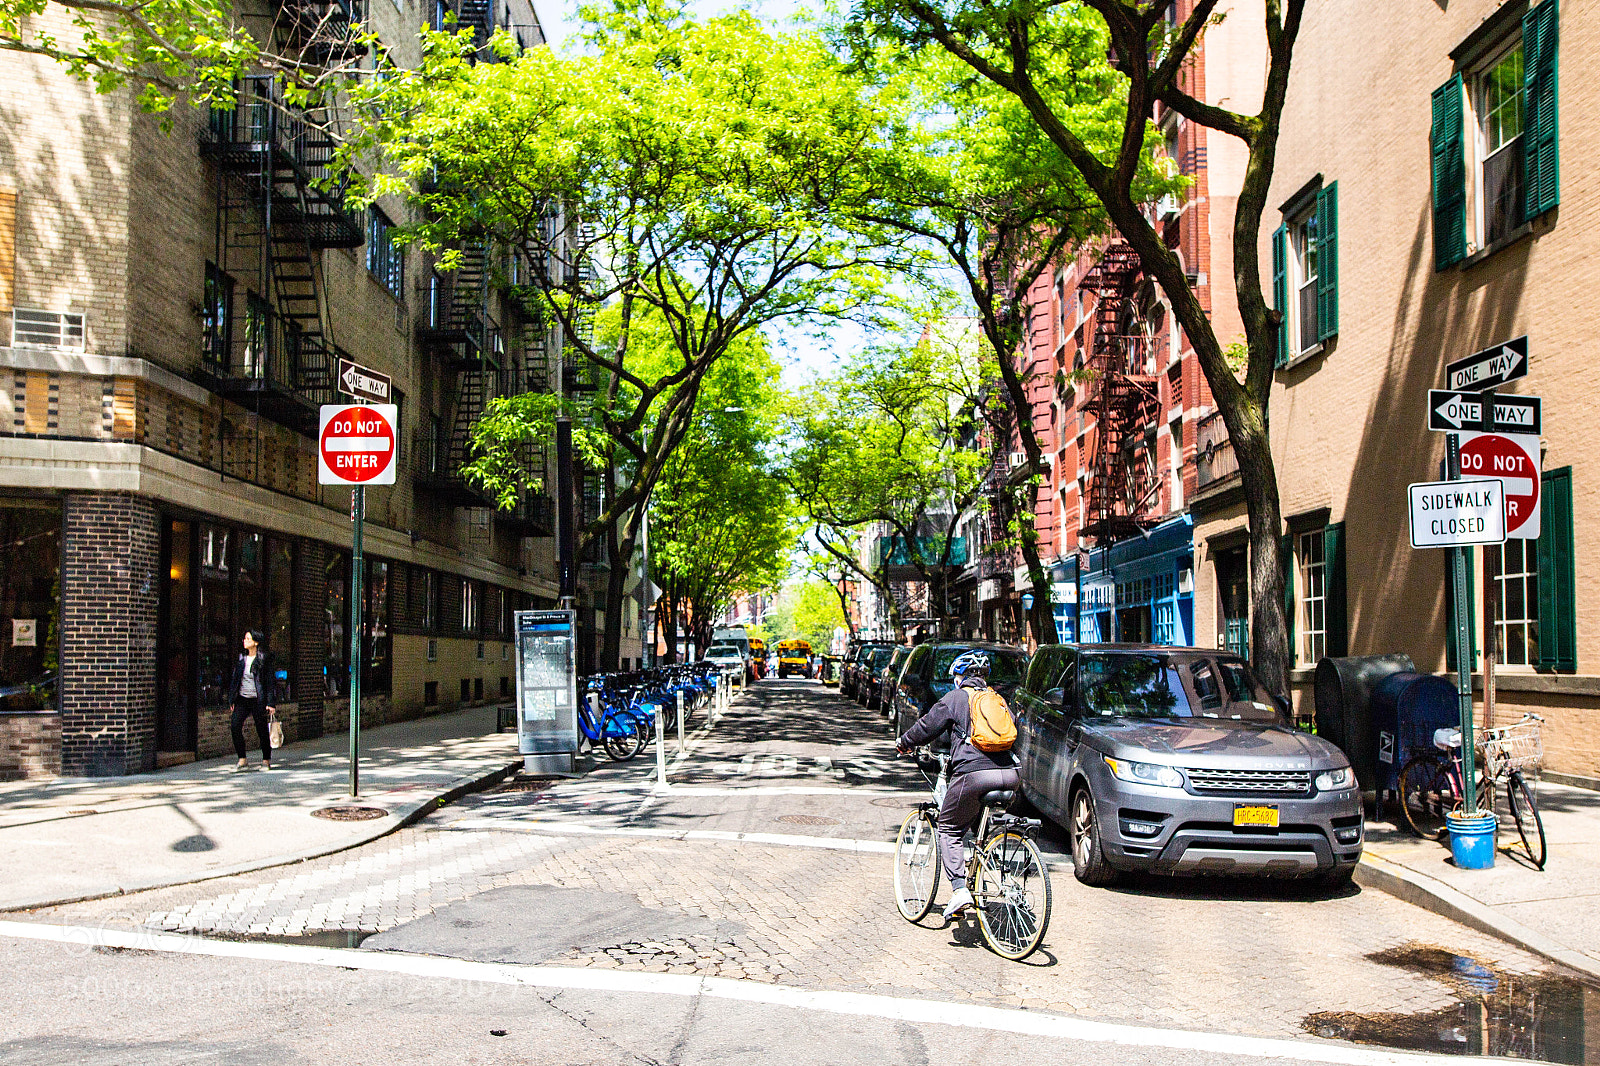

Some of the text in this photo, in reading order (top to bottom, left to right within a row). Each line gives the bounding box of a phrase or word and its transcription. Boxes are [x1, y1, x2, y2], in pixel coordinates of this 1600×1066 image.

[1456, 352, 1515, 387] ONE WAY
[347, 372, 385, 395] ONE WAY
[1447, 403, 1527, 423] ONE WAY
[334, 420, 383, 434] DO NOT
[336, 454, 378, 468] ENTER
[1460, 453, 1525, 472] DO NOT
[1421, 490, 1492, 511] SIDEWALK
[1431, 517, 1485, 536] CLOSED
